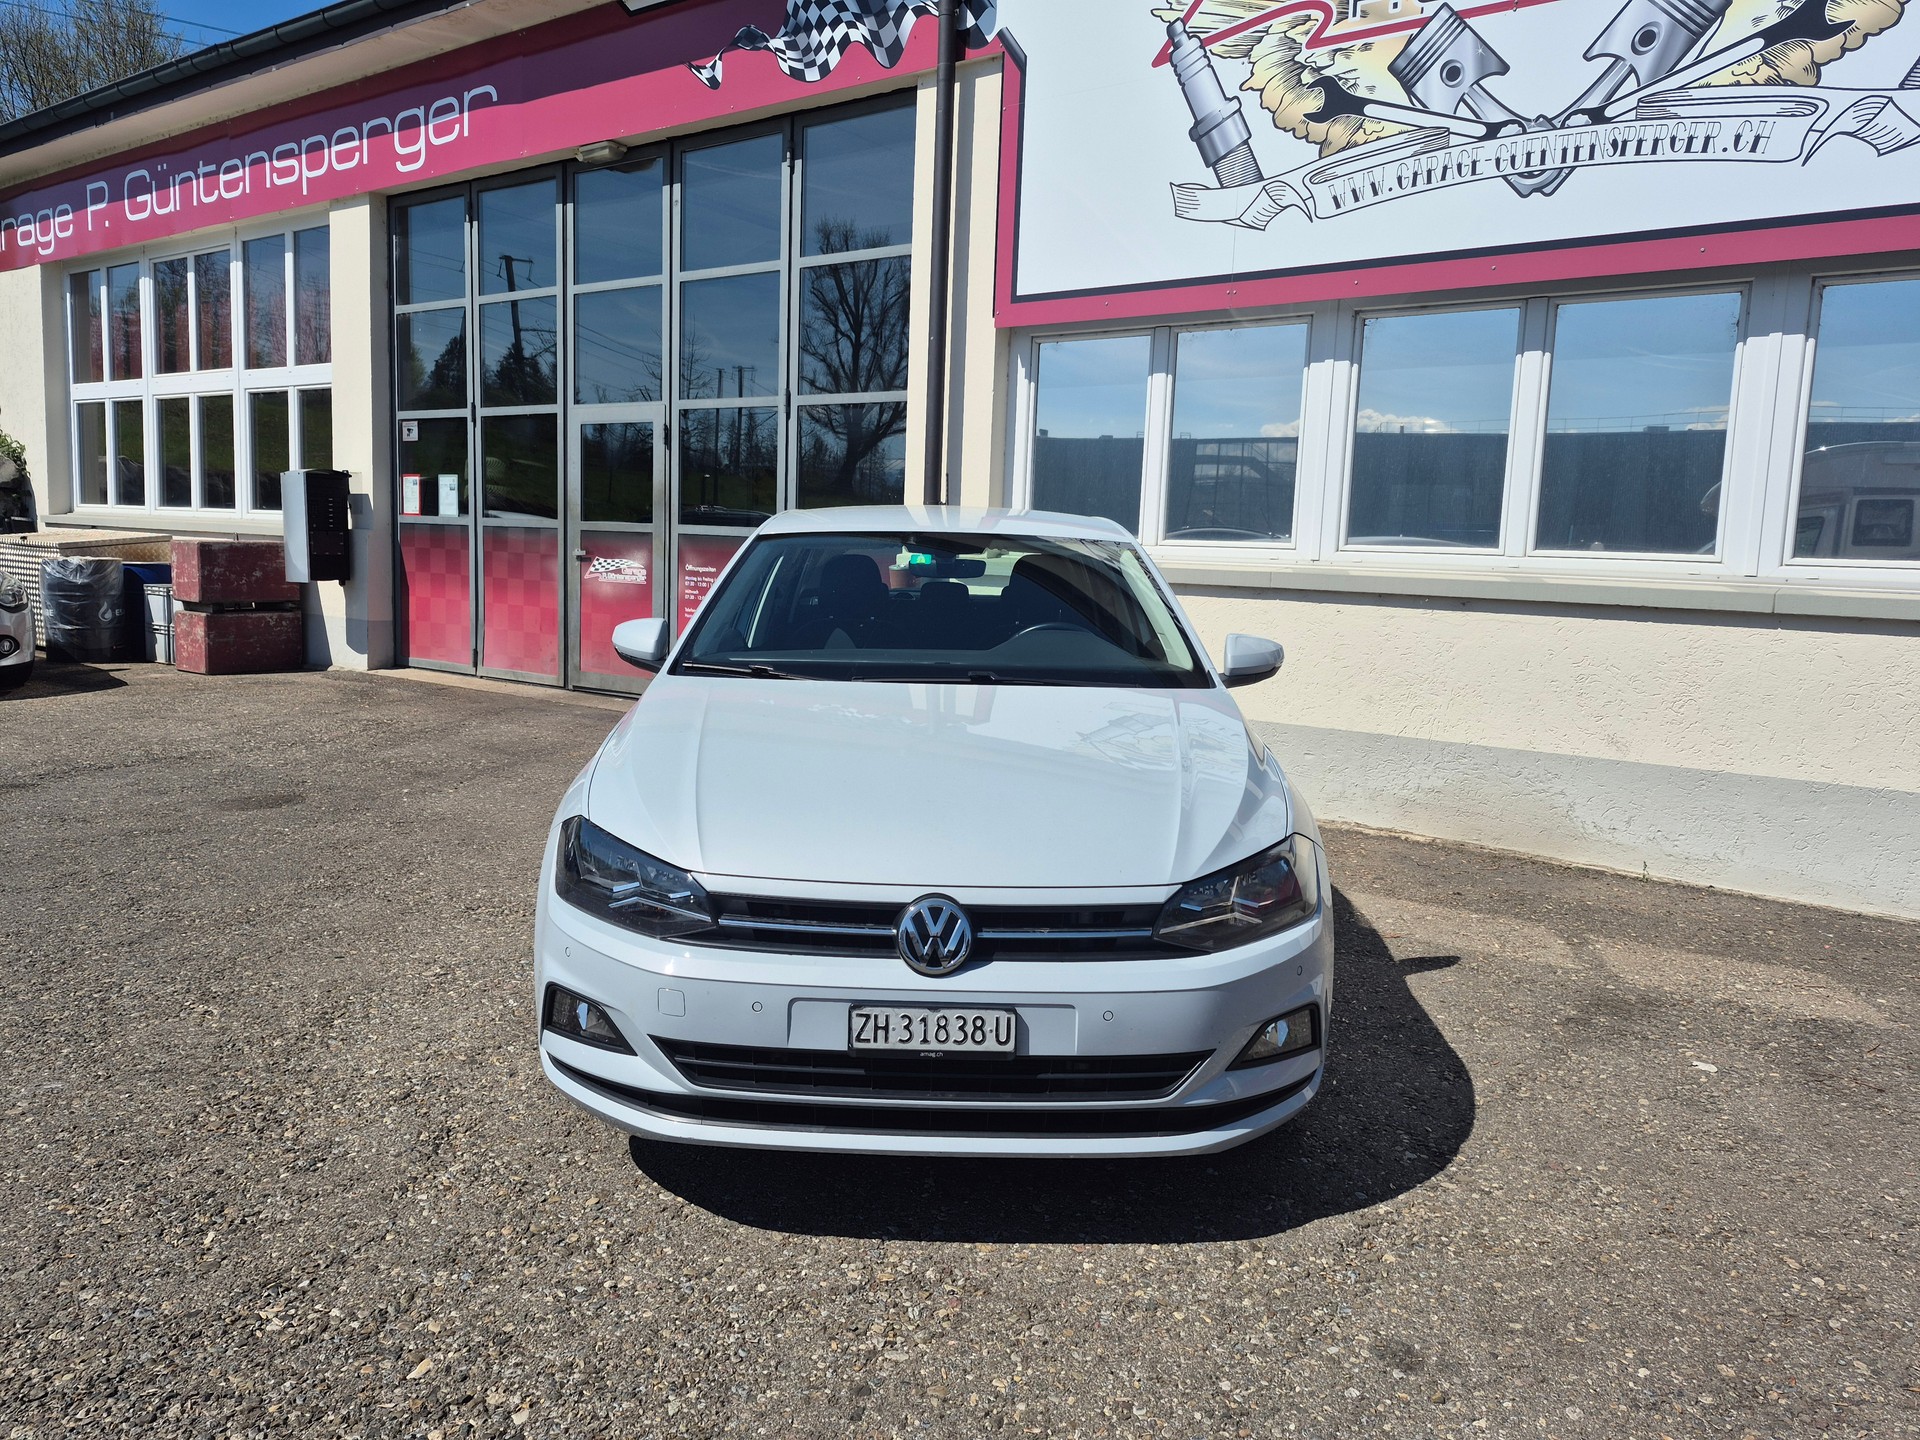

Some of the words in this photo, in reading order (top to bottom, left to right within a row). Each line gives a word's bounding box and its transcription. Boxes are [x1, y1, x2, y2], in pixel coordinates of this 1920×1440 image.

[0, 202, 74, 256] rage
[86, 180, 110, 231] P.
[124, 84, 498, 221] Güntensperger
[1329, 119, 1777, 210] WWW.GARAGE-GUENTENSPERGER.CH
